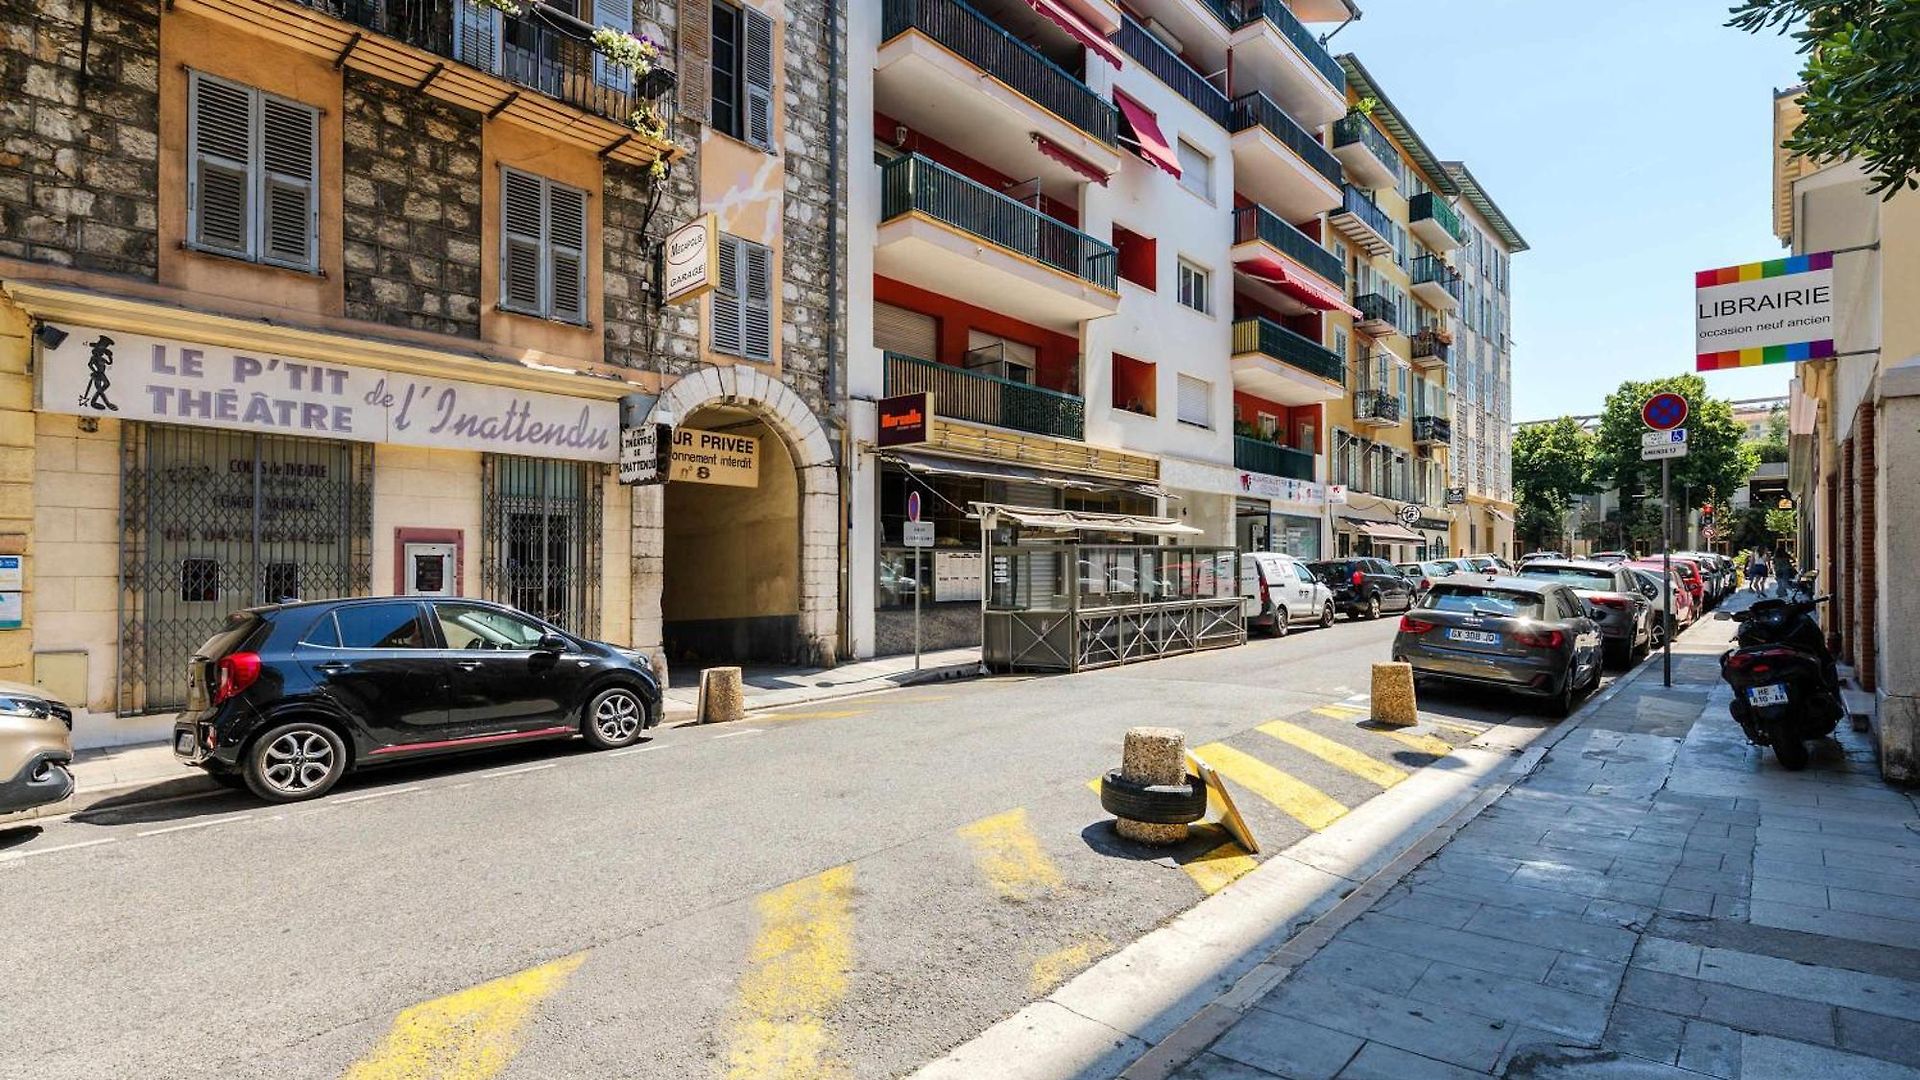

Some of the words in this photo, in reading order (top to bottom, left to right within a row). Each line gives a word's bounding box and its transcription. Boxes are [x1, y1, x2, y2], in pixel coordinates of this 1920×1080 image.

[671, 264, 704, 287] GARAGE
[1699, 286, 1830, 319] LIBRAIRIE
[1699, 326, 1752, 339] occasion
[1756, 319, 1784, 331] neuf
[1787, 314, 1830, 327] ancien
[152, 344, 204, 377] LE
[233, 356, 349, 395] P'TIT
[364, 378, 395, 408] de
[146, 384, 352, 432] THÉÂTRE
[672, 431, 693, 446] UR
[696, 466, 710, 479] 8
[720, 457, 752, 469] interdit
